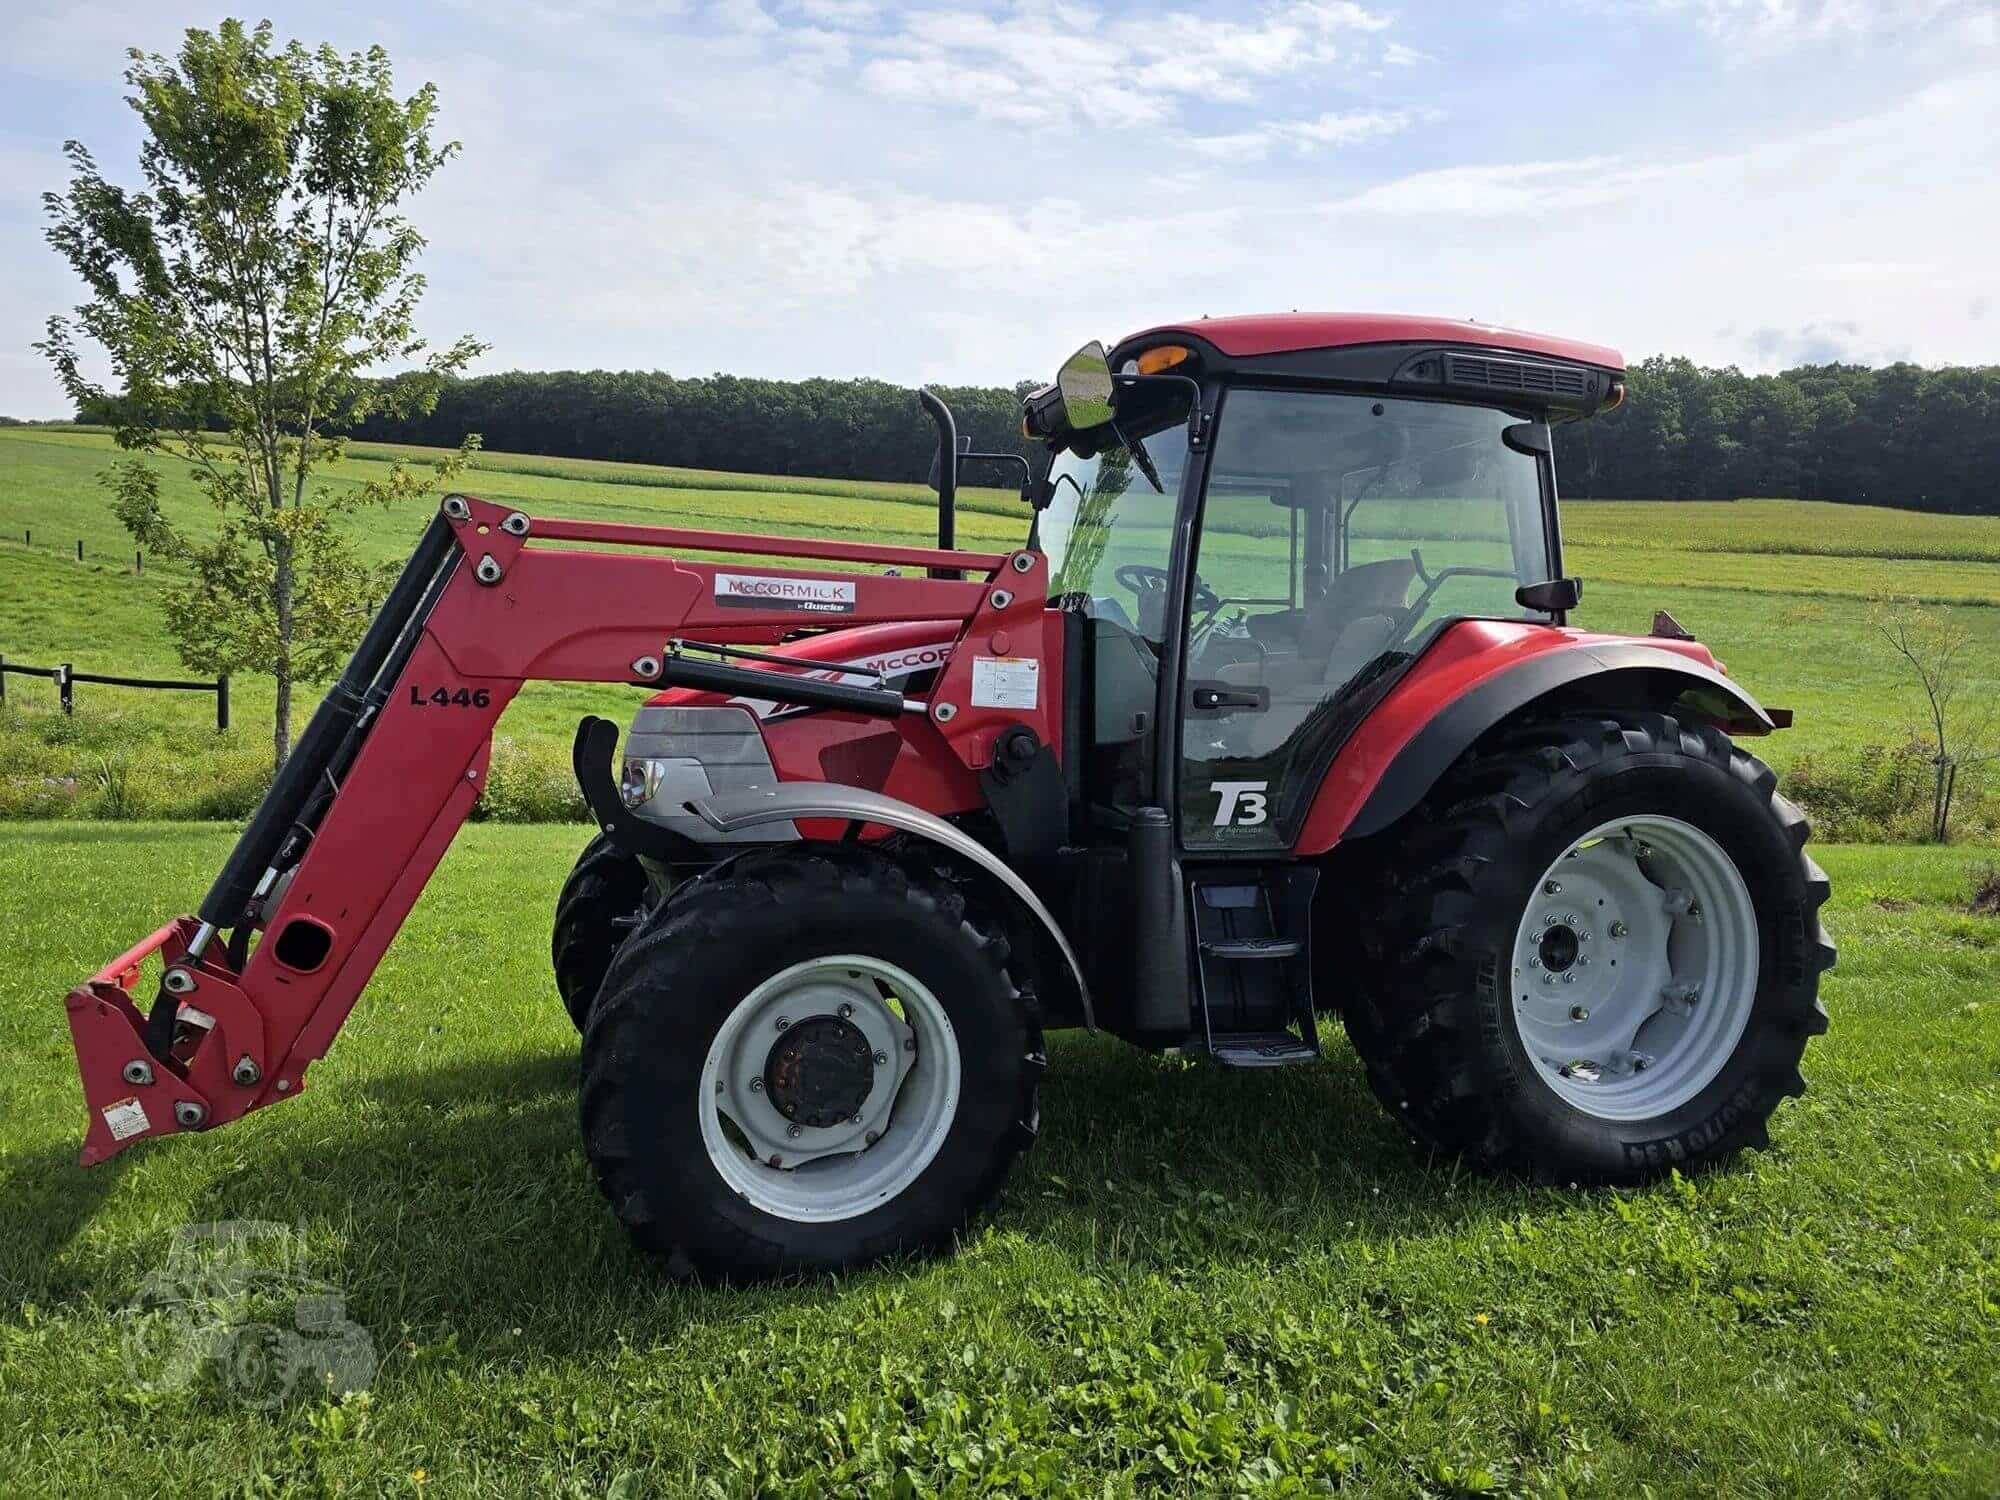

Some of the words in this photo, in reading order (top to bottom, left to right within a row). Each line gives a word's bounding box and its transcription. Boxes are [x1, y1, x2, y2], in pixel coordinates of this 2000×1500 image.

[729, 581, 845, 599] McCORMICK
[411, 687, 490, 708] L446
[1210, 781, 1268, 826] T3
